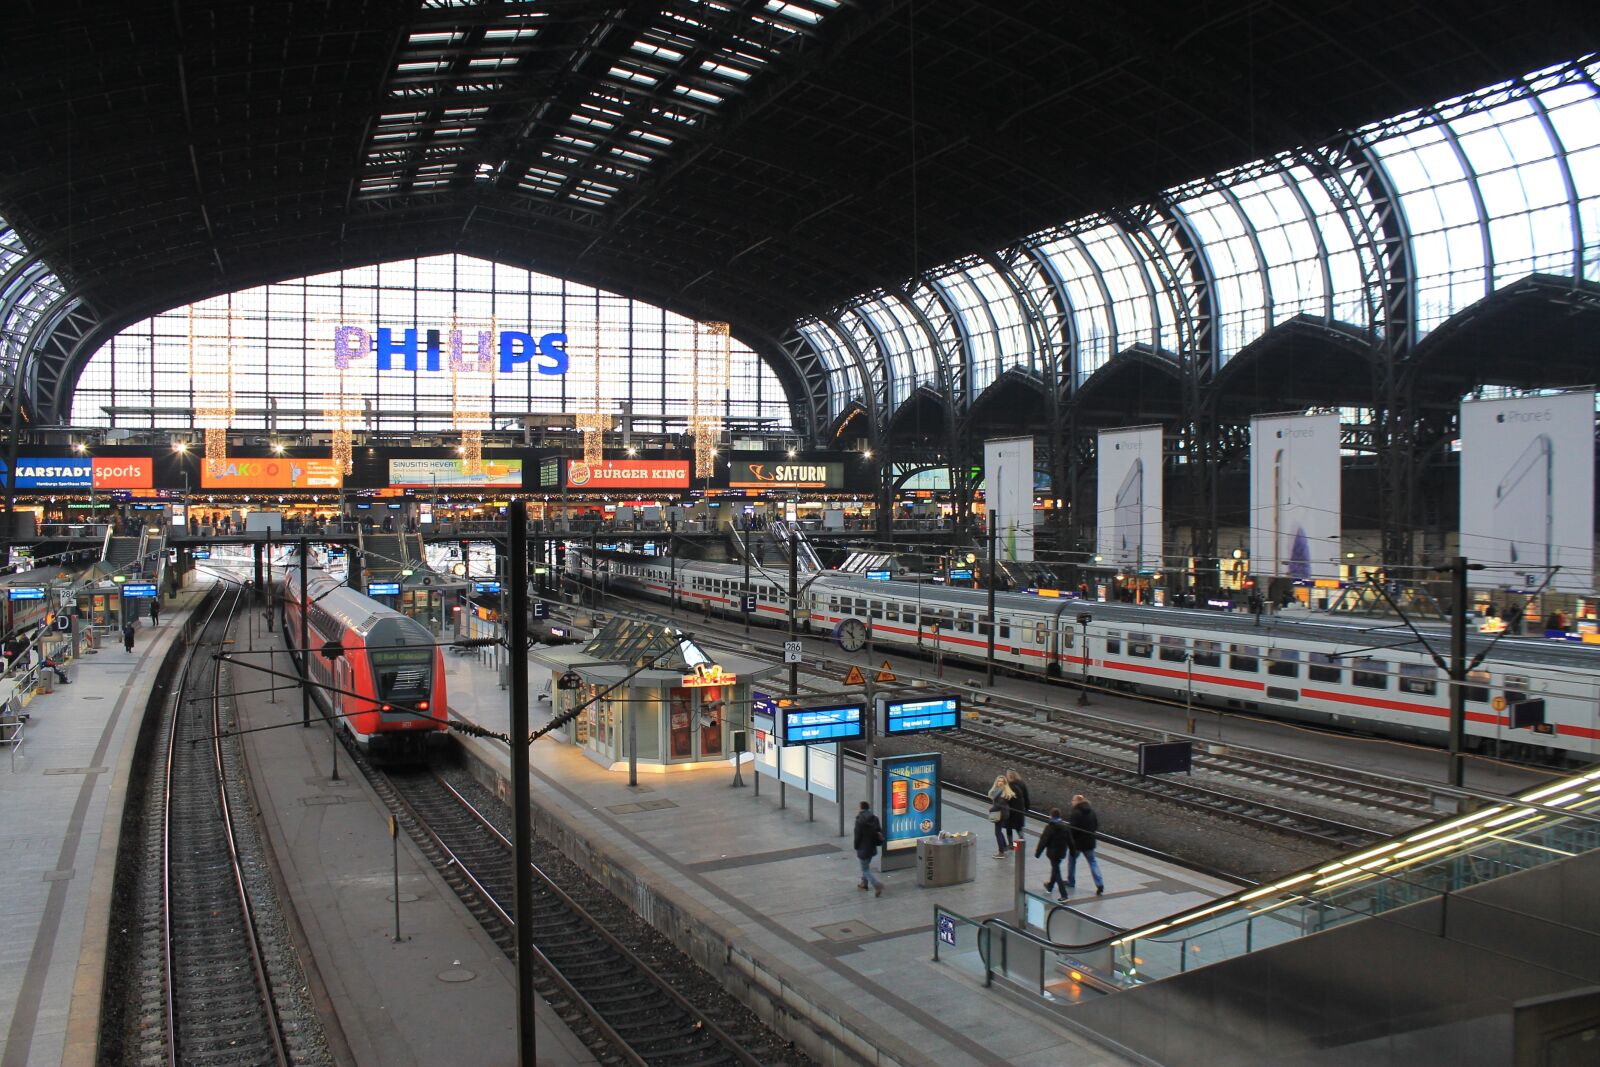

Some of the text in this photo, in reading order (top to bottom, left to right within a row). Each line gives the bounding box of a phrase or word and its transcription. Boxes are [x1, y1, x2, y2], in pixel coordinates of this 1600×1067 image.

[334, 326, 570, 376] PHILIPS
[15, 464, 141, 480] KARSTADT sports
[572, 470, 588, 479] KING
[593, 469, 686, 479] BURGER KING
[775, 465, 826, 481] SATURN
[747, 596, 755, 609] E
[534, 603, 543, 617] E
[57, 615, 69, 630] D
[786, 642, 801, 652] 286
[946, 700, 956, 710] 8a
[787, 713, 798, 724] 7a
[926, 856, 934, 880] Abfall
